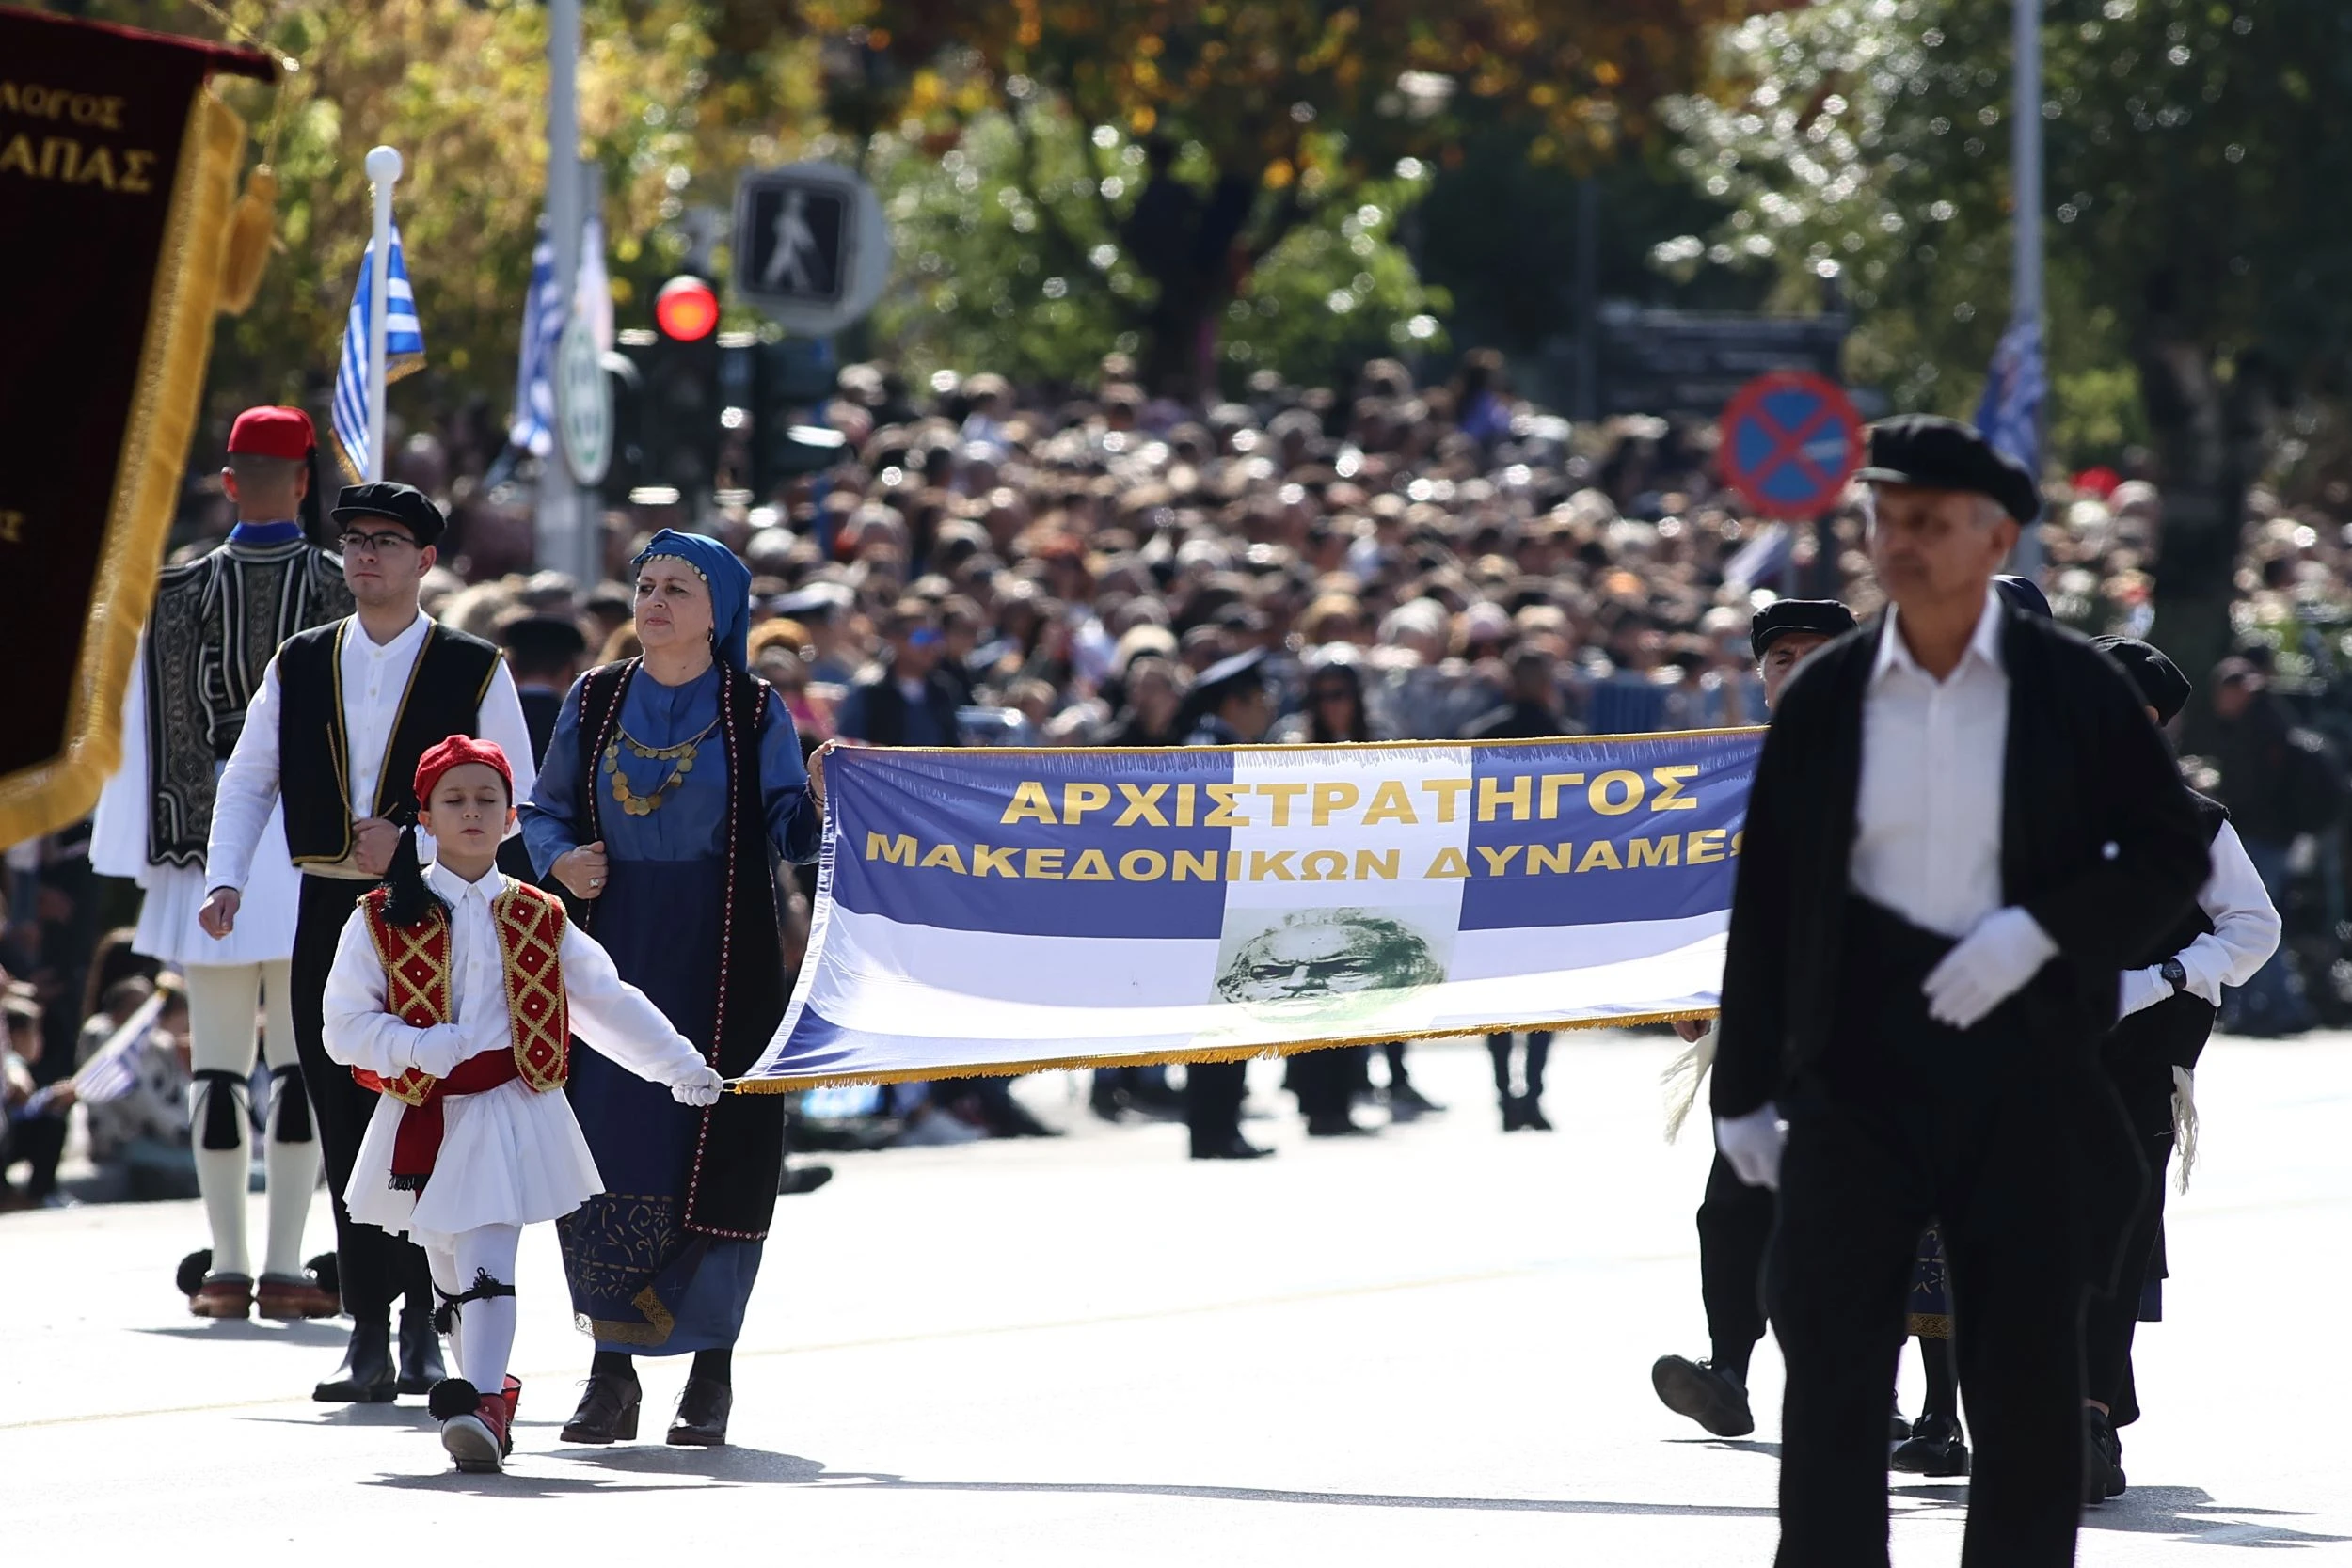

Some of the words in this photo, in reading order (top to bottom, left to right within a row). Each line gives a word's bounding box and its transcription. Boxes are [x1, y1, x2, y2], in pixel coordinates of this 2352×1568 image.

[1000, 765, 1699, 827] ΑΡΧΙΣΤΡΑΤΗΓΟΣ
[866, 831, 1402, 881] ΜΑΚΕΔΟΝΙΚΩΝ
[1423, 829, 1743, 878] ΔΥΝΑΜΕ
